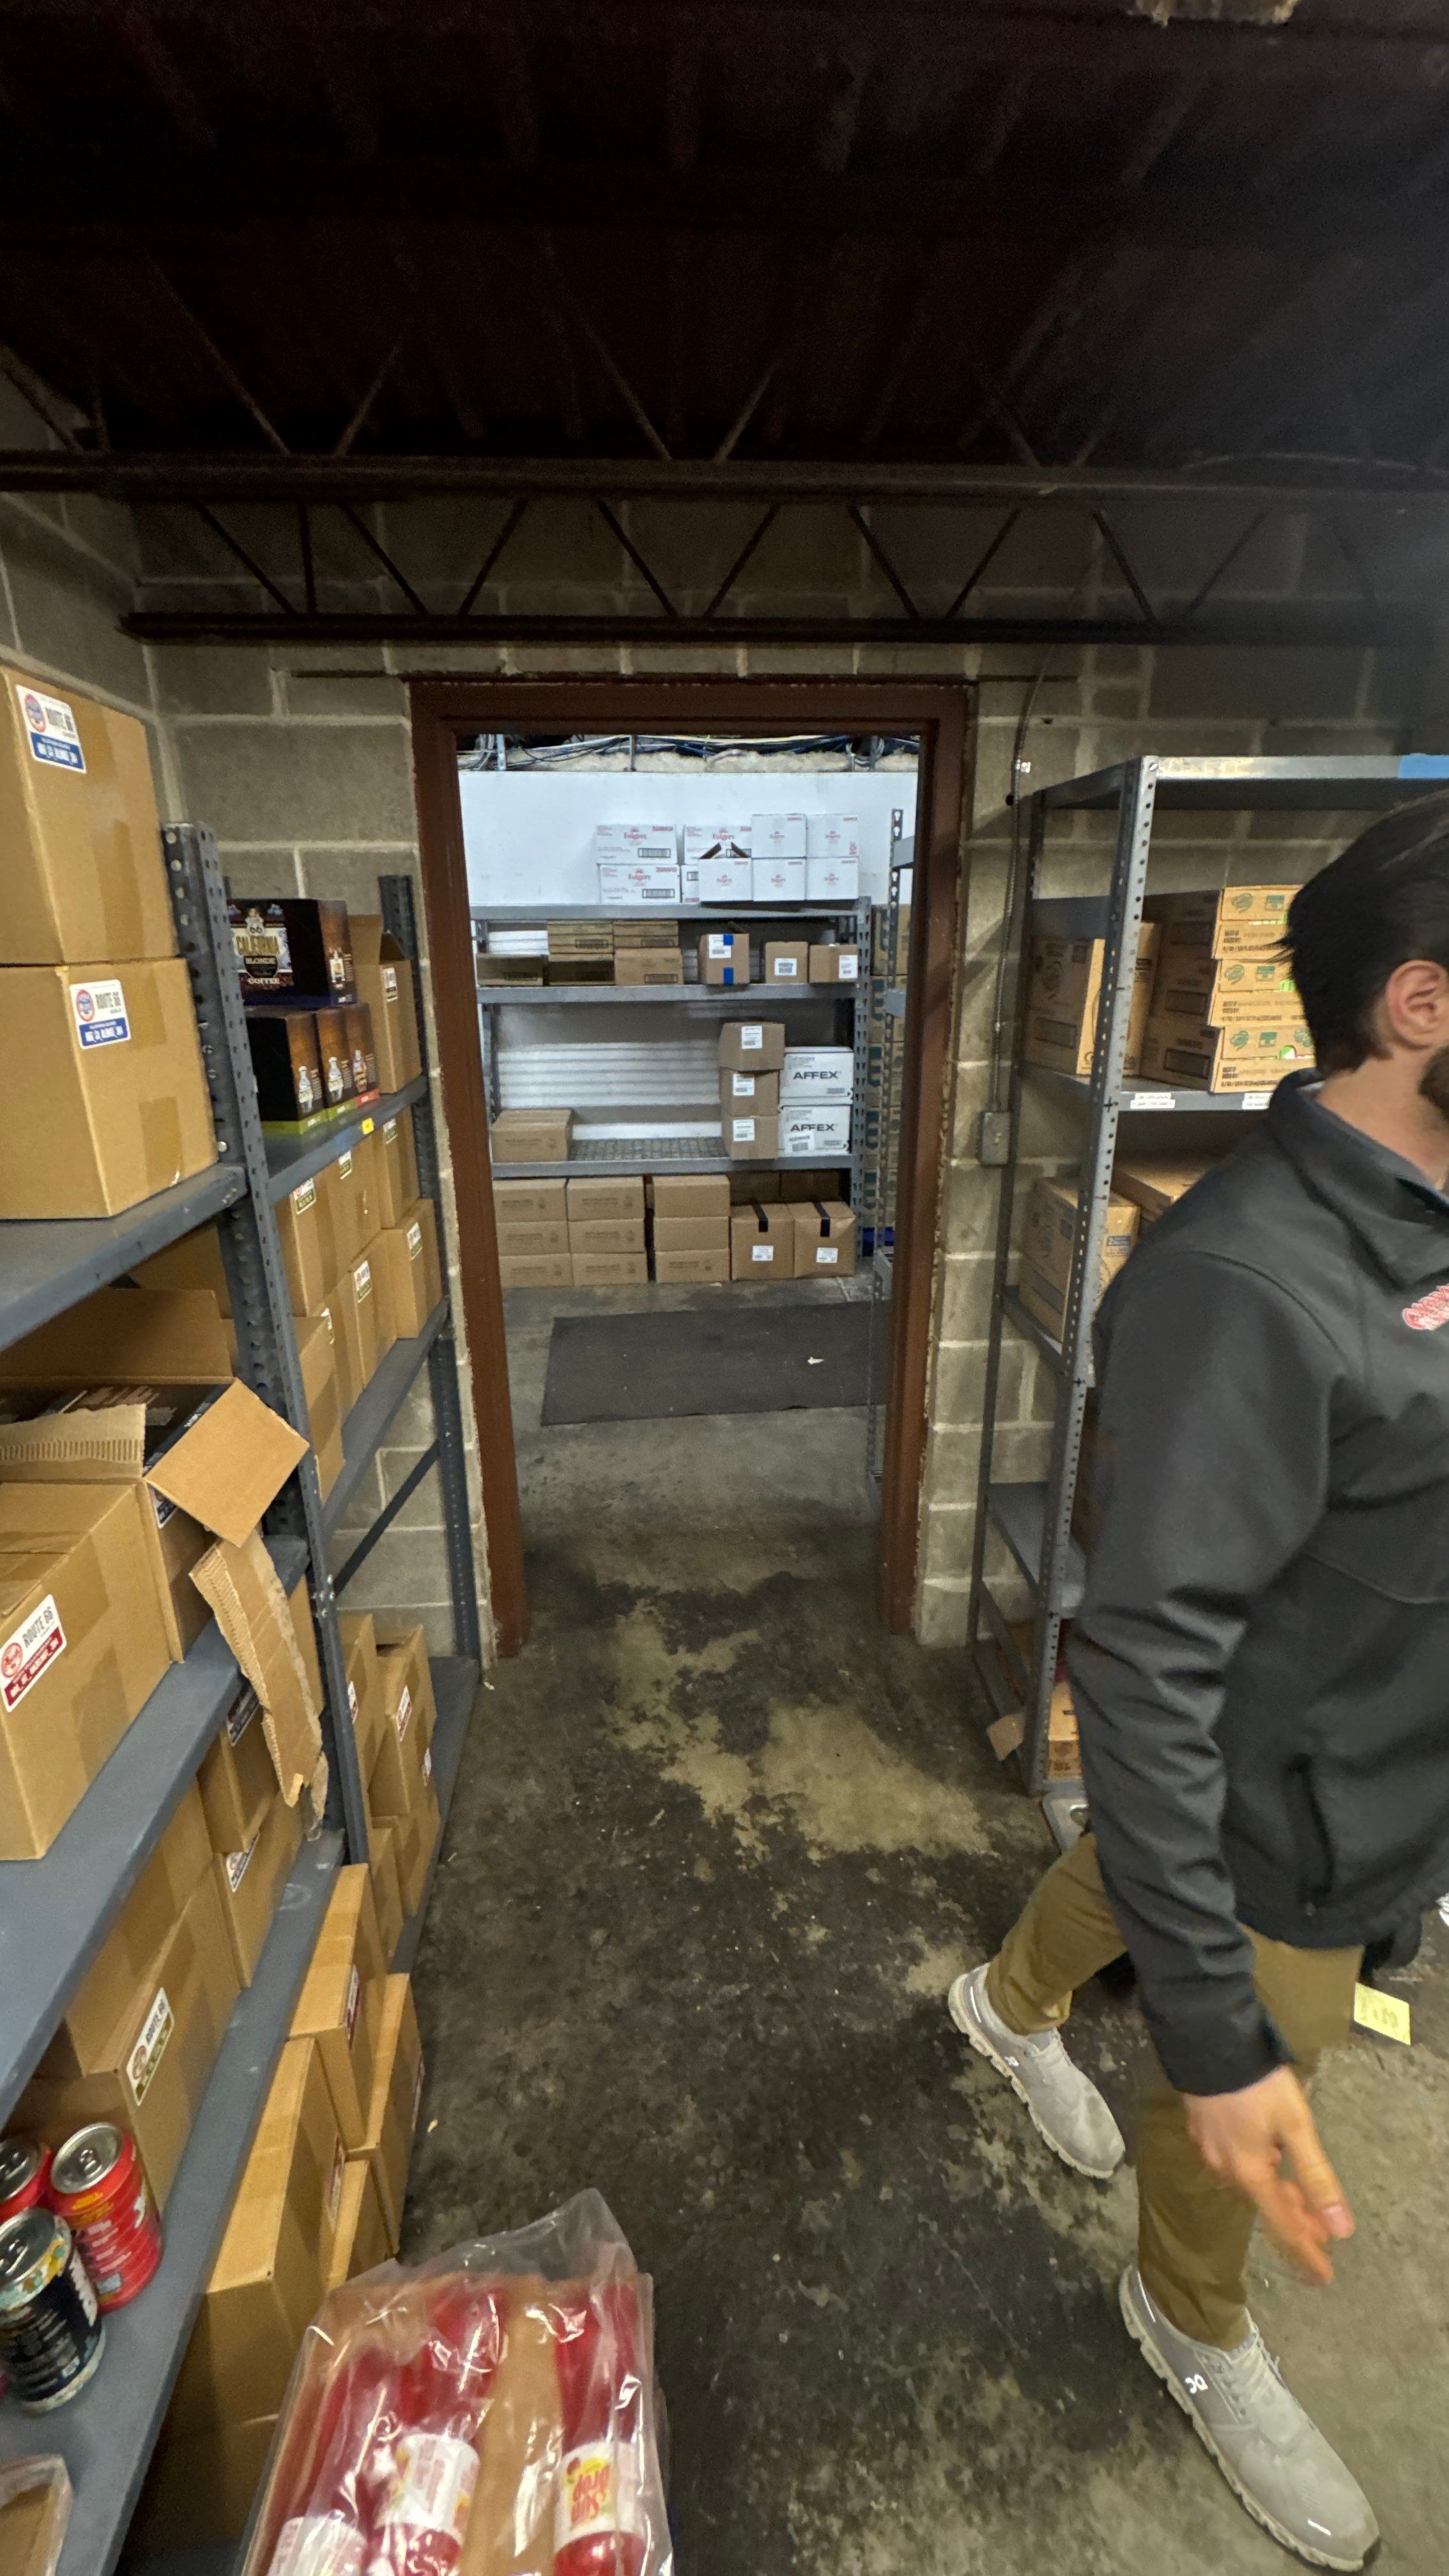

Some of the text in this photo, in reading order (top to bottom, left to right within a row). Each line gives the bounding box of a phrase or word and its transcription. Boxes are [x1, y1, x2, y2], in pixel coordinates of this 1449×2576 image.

[793, 1071, 838, 1080] AFFEX
[790, 1124, 834, 1132] AFFEX
[22, 1606, 54, 1648] ROUTE 66
